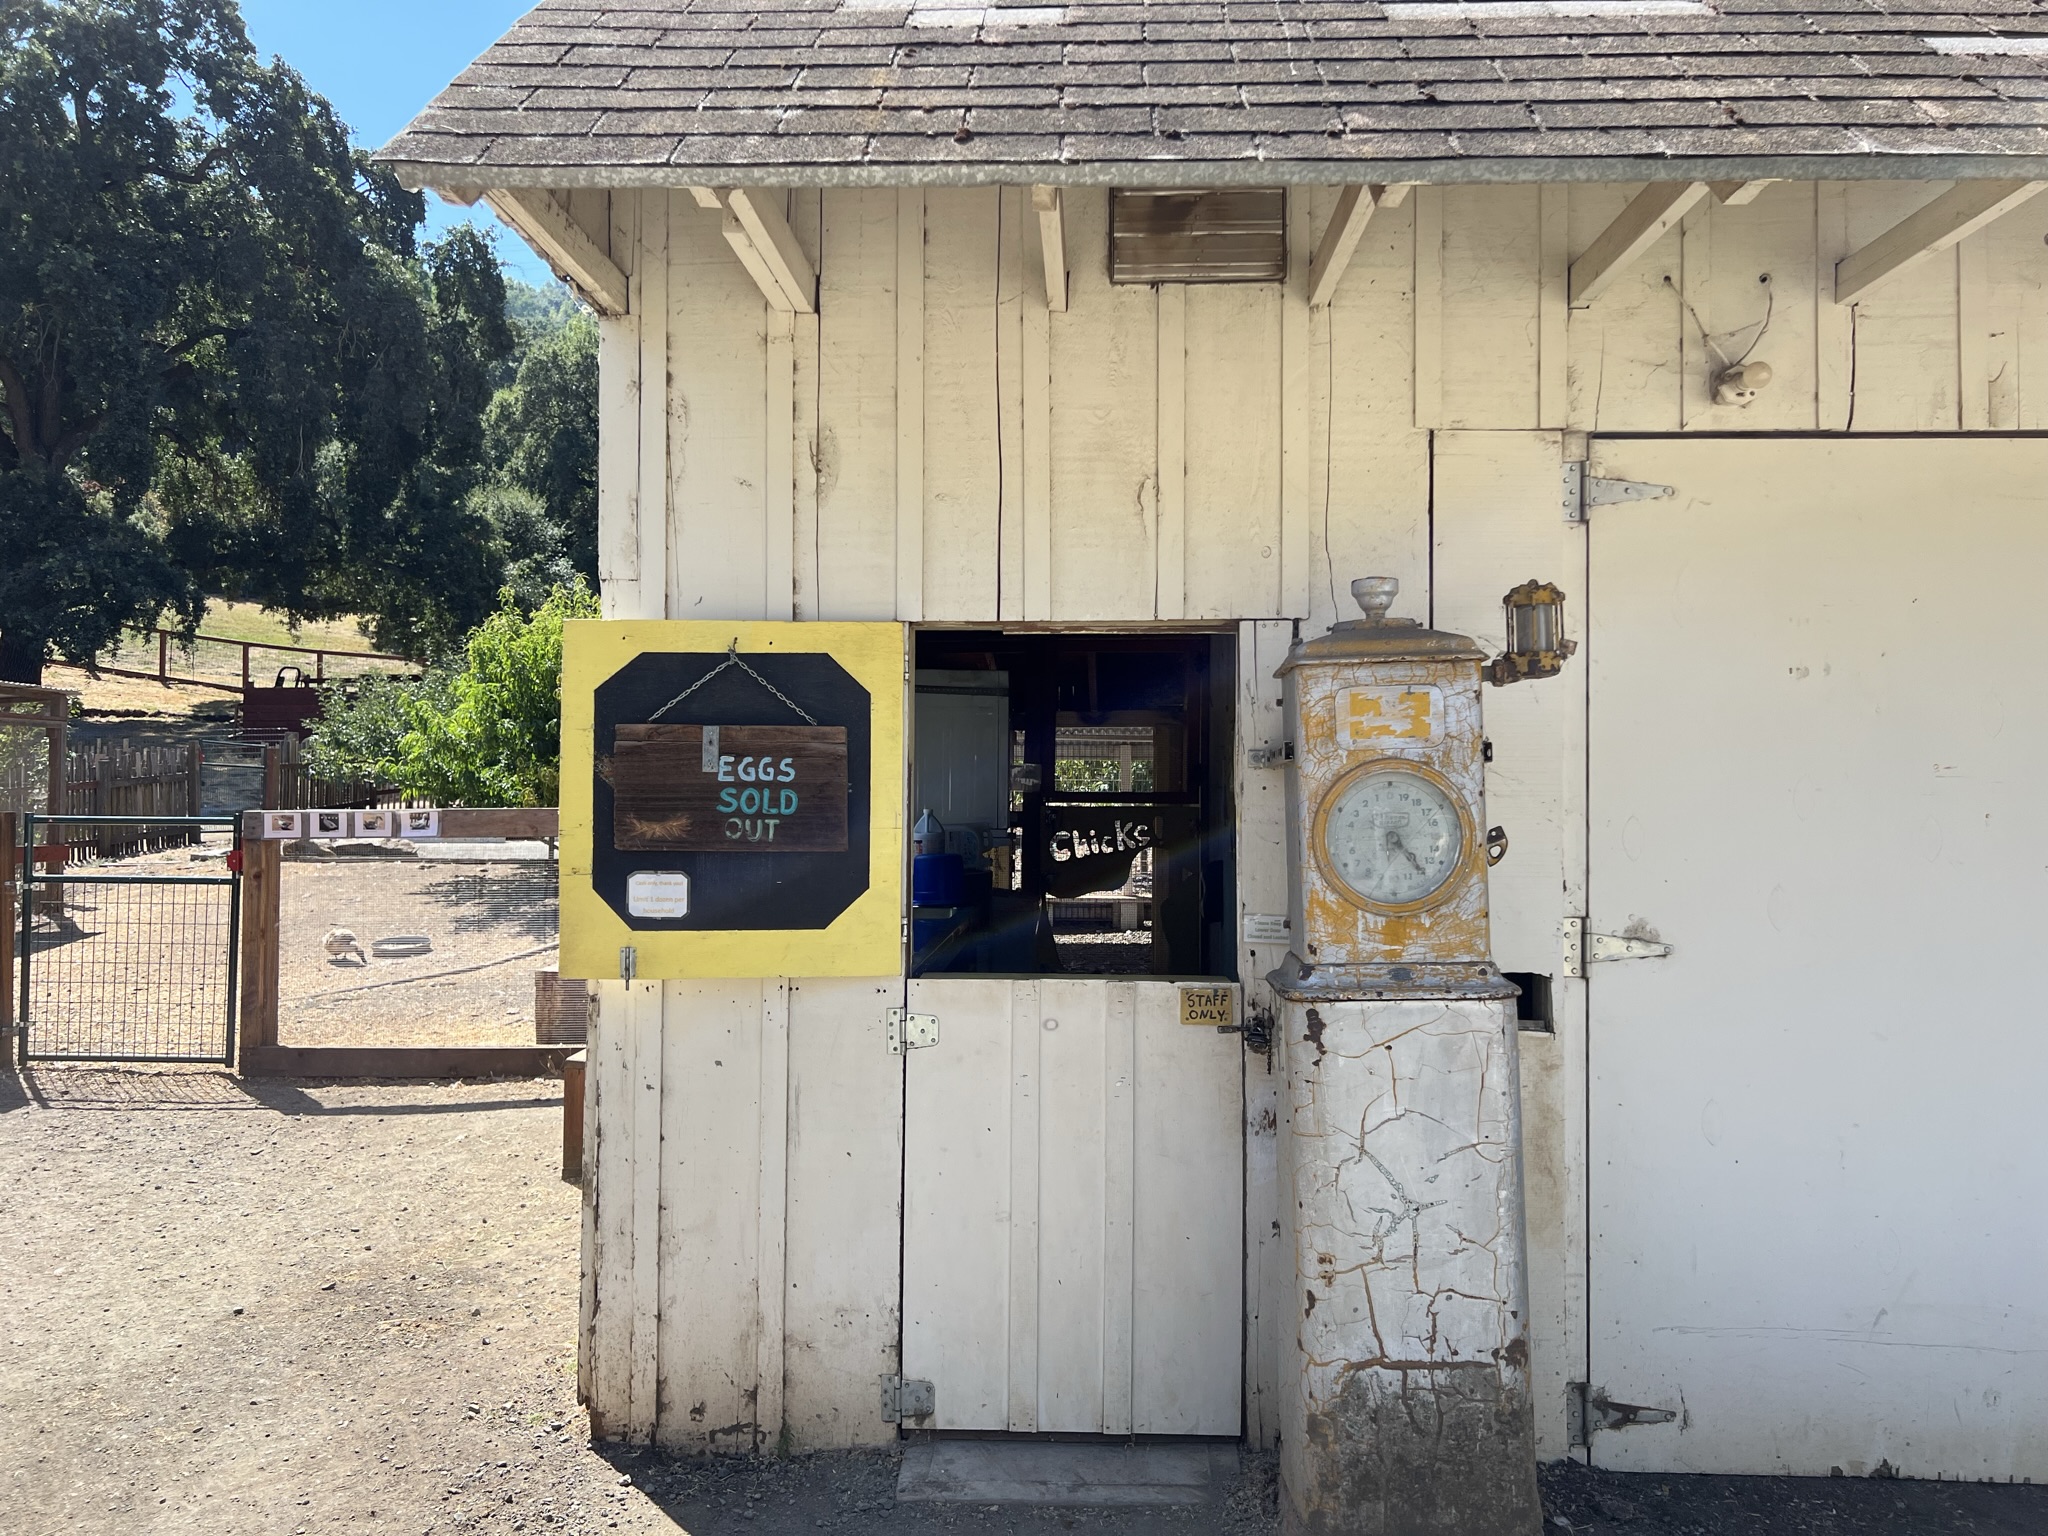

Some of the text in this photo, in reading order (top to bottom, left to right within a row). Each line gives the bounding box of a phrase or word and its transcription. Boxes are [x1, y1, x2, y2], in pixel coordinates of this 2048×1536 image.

[718, 755, 796, 783] EGGS
[716, 787, 799, 815] SOLD
[1374, 794, 1380, 802] 1
[1398, 793, 1410, 802] 19
[1362, 799, 1369, 808] 2
[1411, 798, 1422, 807] 18
[1353, 809, 1360, 818] 3
[1421, 808, 1433, 817] 17
[1345, 820, 1355, 829] 4
[724, 817, 780, 843] OUT
[1349, 846, 1356, 855] 6
[1424, 856, 1435, 865] 13
[1403, 872, 1413, 881] 11
[1187, 993, 1229, 1008] STAFF
[1188, 1009, 1226, 1022] ONLY
